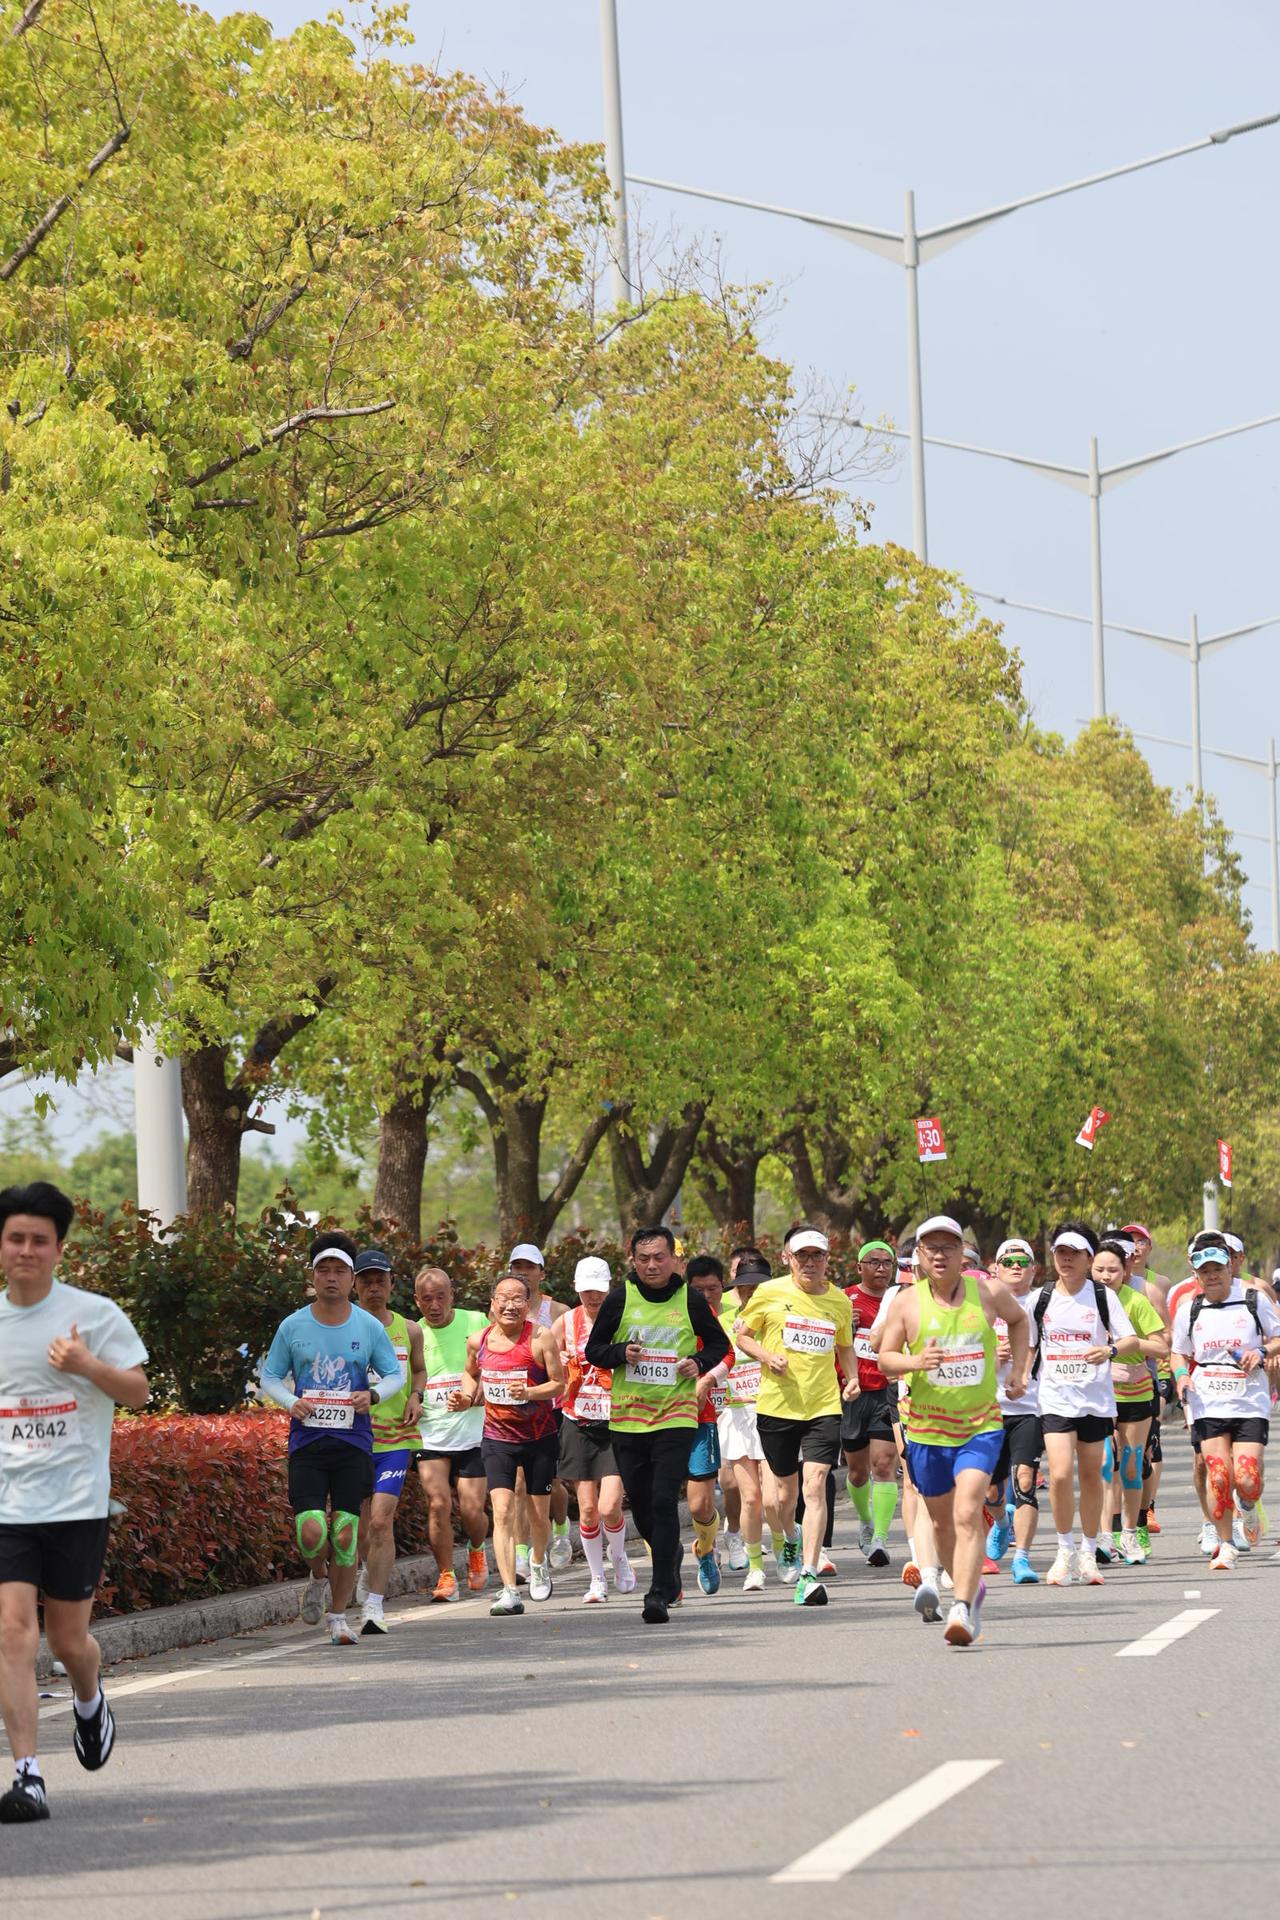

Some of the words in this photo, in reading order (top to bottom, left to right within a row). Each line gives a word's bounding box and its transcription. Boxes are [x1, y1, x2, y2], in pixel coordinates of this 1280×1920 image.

[792, 1333, 827, 1348] A3300
[1049, 1333, 1092, 1342] PACER
[633, 1365, 669, 1378] A0163
[937, 1364, 978, 1379] A3629
[1055, 1363, 1088, 1374] A0072
[488, 1387, 512, 1398] A21
[1208, 1381, 1239, 1391] A3557
[436, 1389, 461, 1402] A1
[309, 1408, 346, 1421] A2279
[12, 1420, 67, 1440] A2642
